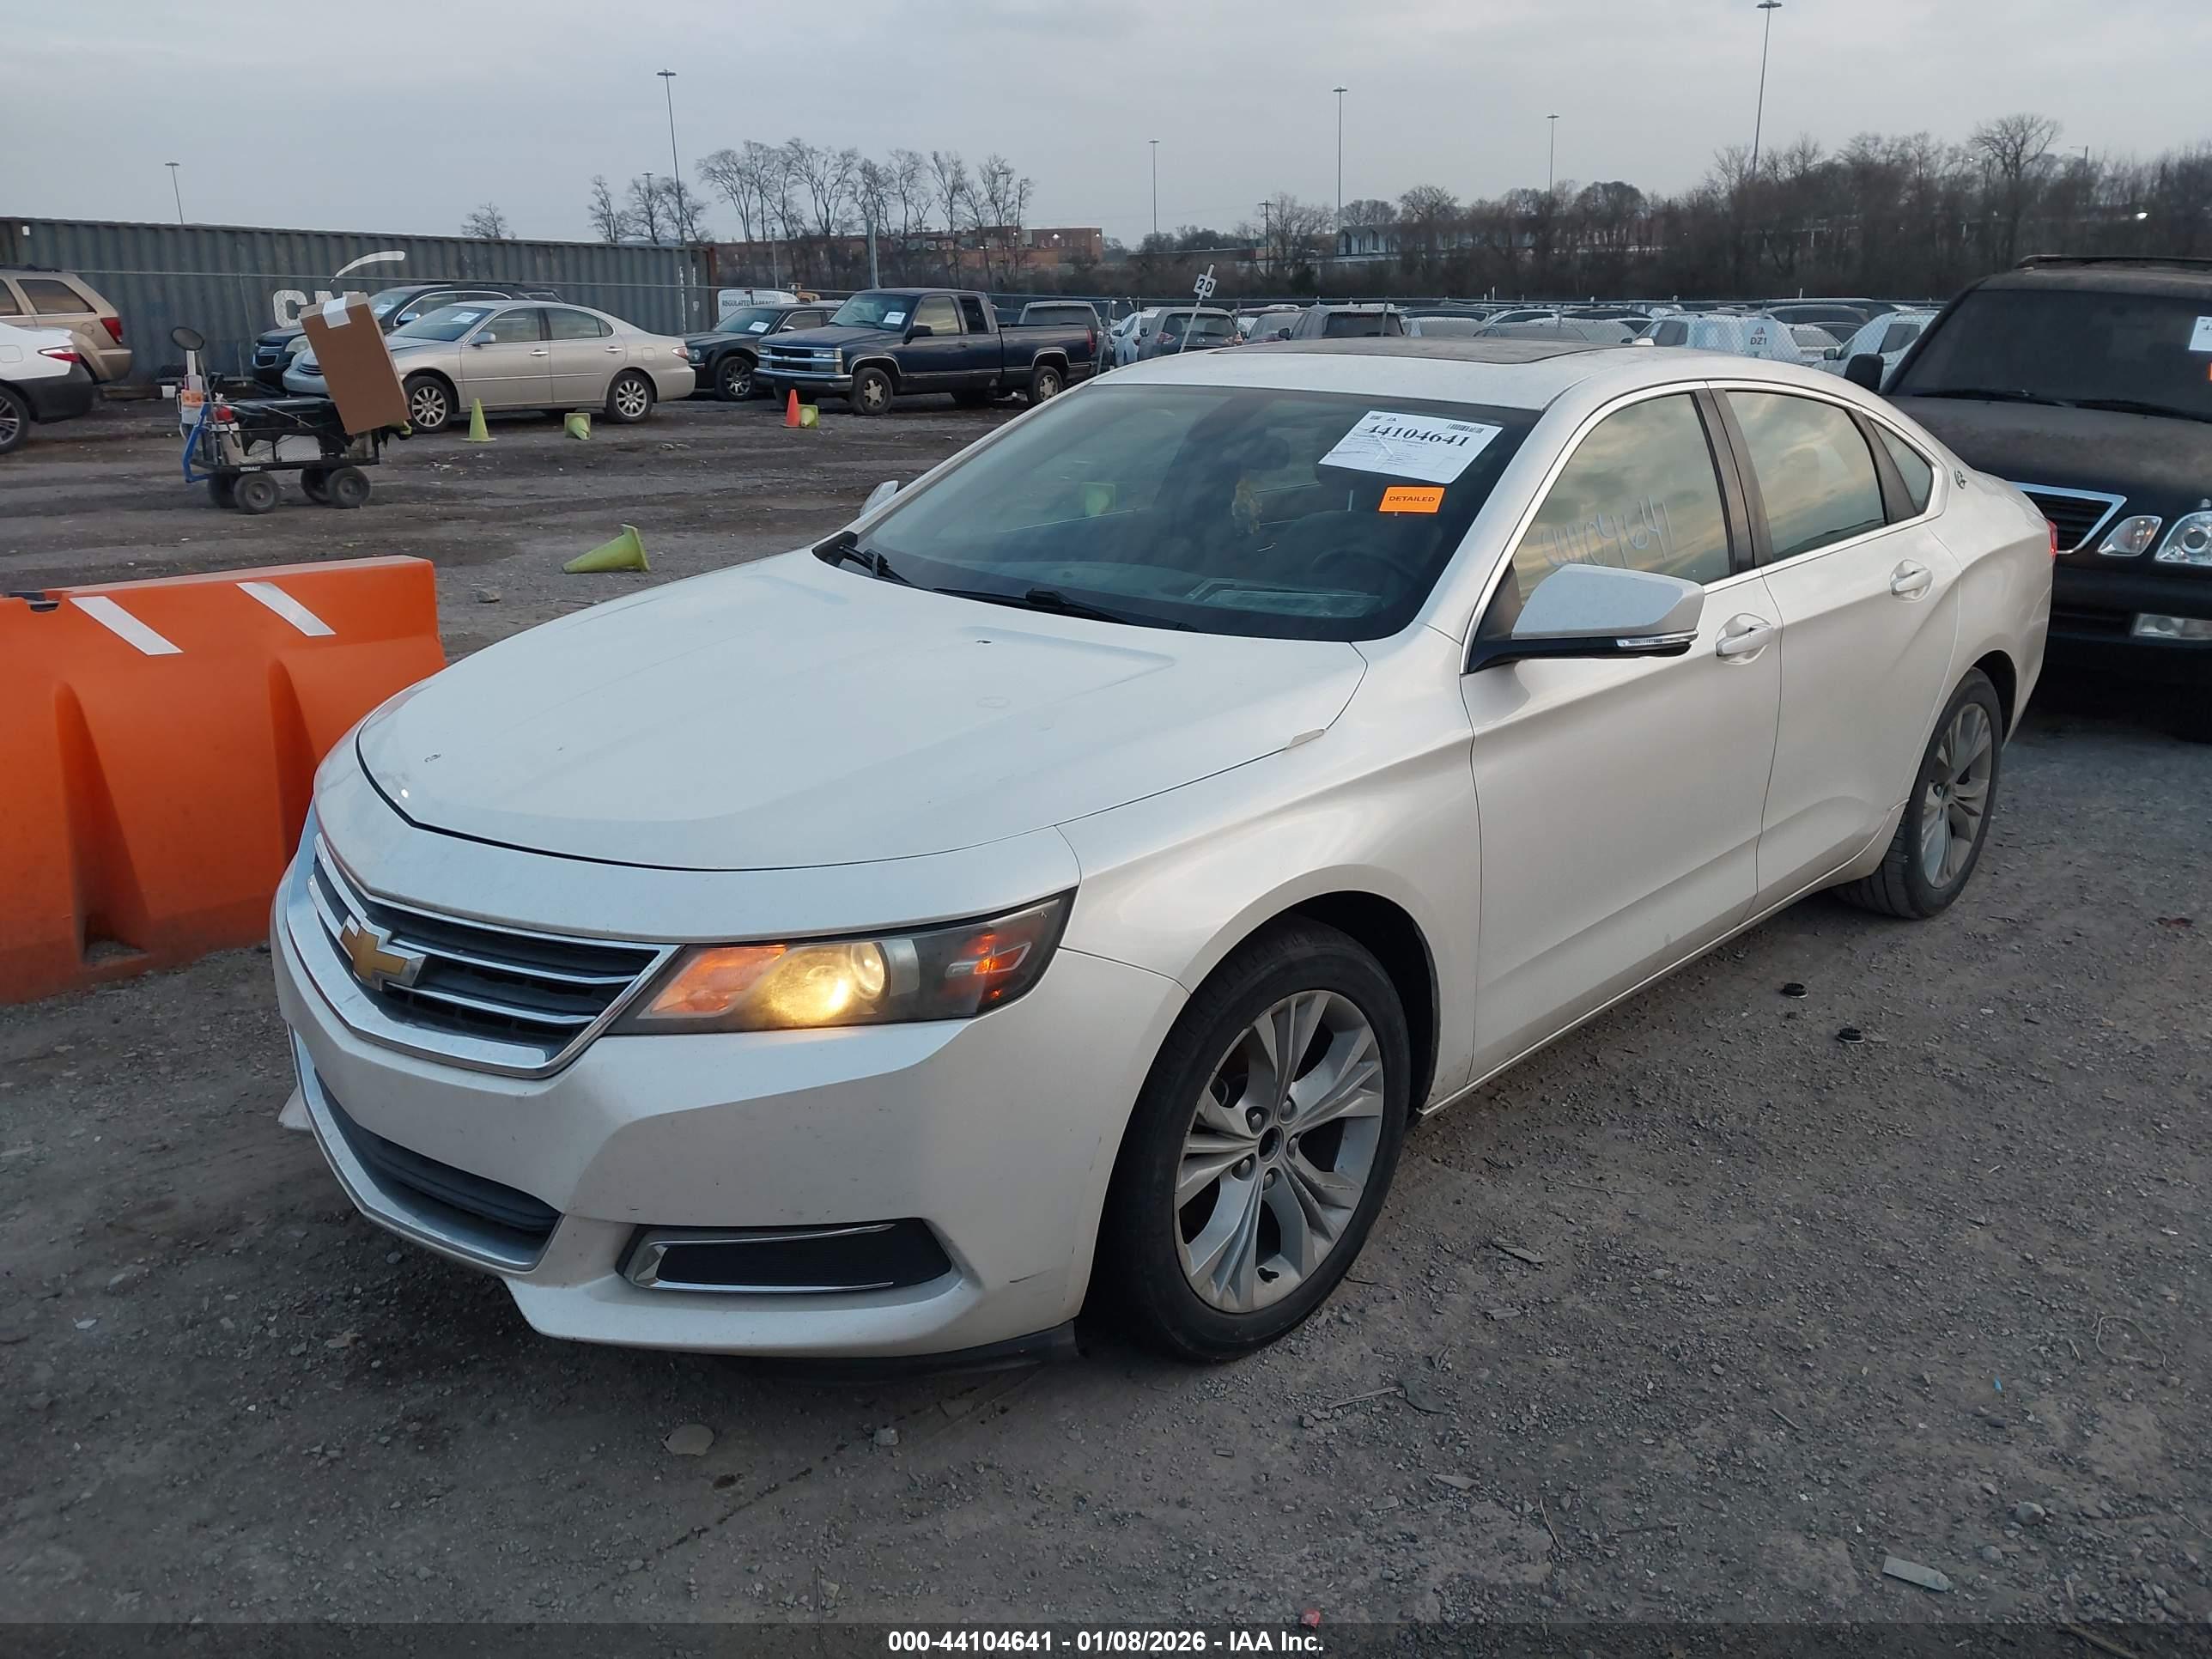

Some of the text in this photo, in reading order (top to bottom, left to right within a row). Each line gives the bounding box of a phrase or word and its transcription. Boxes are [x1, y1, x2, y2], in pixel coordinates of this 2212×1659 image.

[1197, 278, 1213, 293] 20
[1750, 337, 1767, 345] DZ1
[1365, 423, 1470, 447] 44104641
